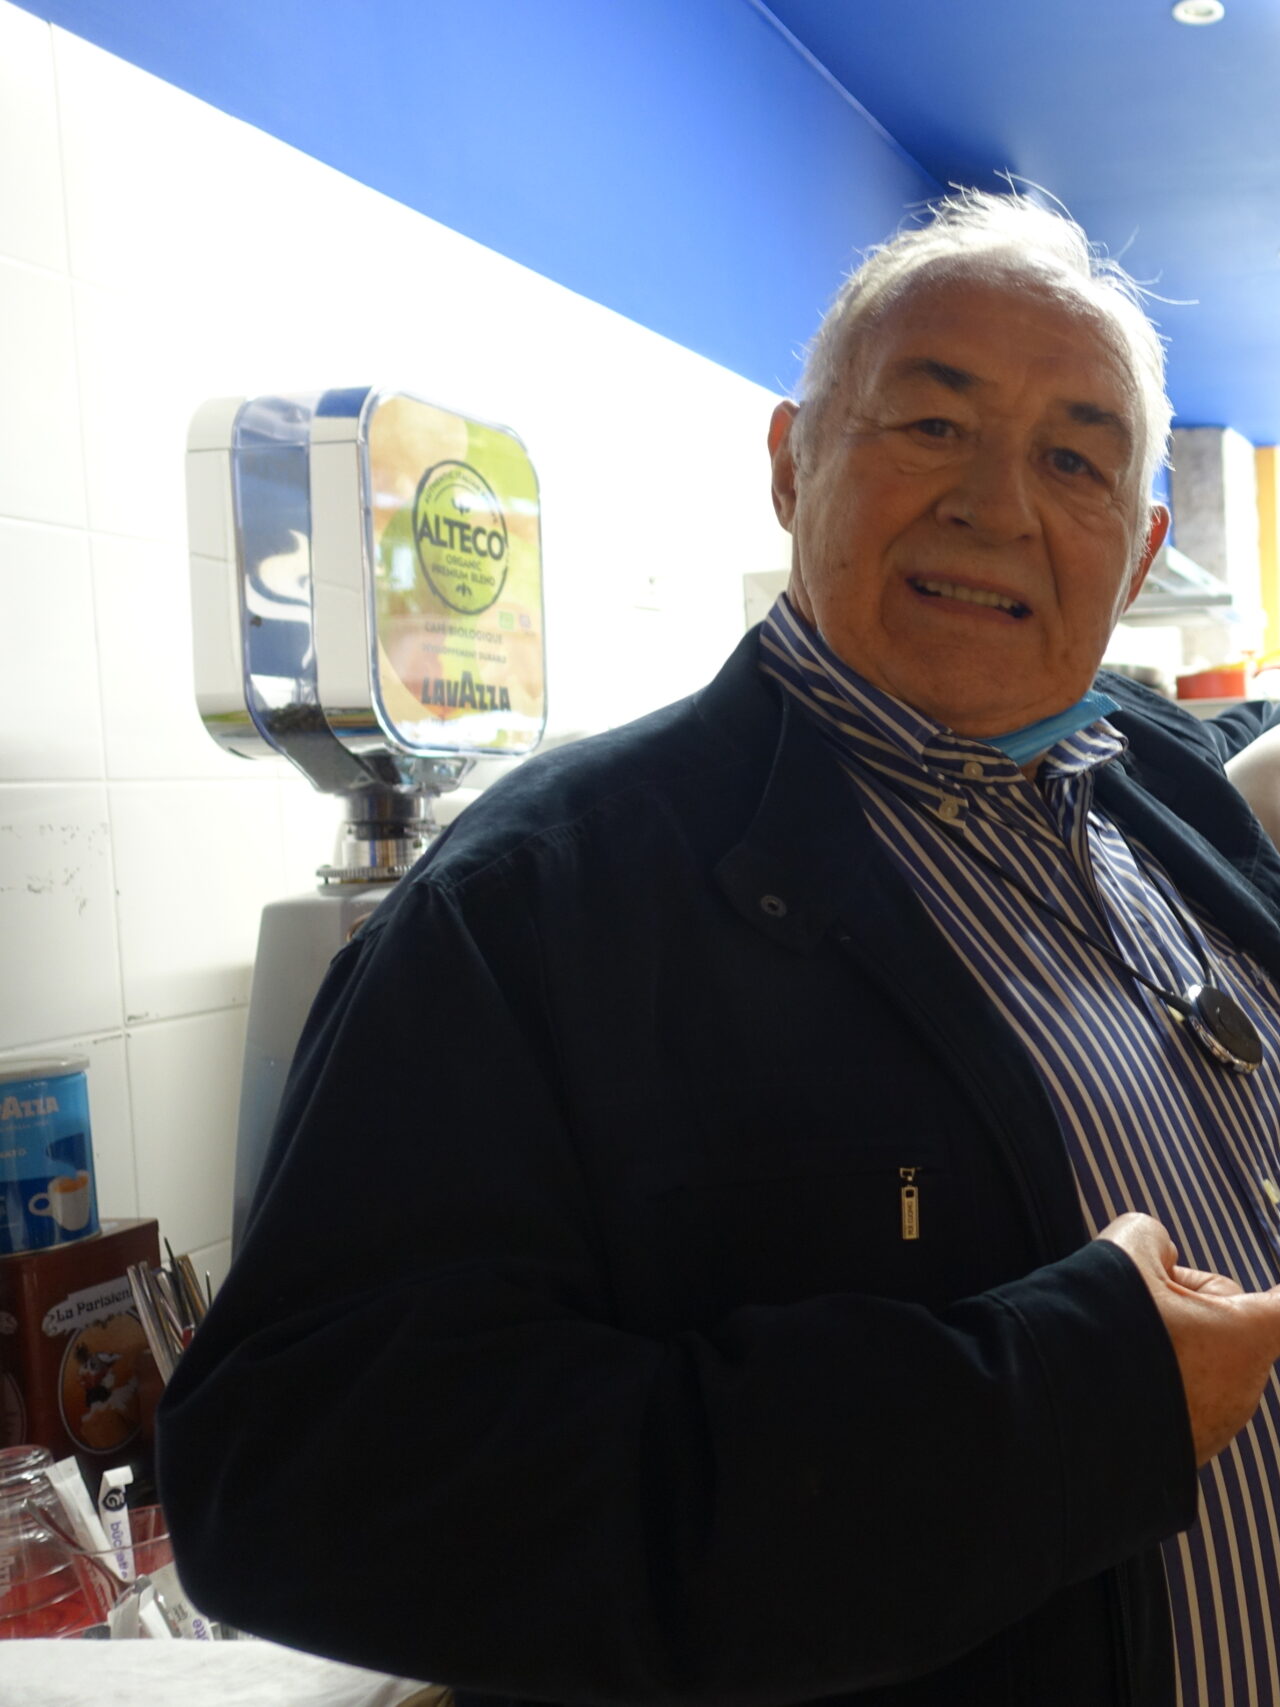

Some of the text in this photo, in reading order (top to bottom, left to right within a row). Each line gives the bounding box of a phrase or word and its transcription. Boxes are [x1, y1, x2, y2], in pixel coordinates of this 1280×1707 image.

[416, 511, 506, 561] ALTECO
[420, 670, 512, 713] LAVAZZA
[0, 1096, 60, 1121] AZZA
[55, 1307, 74, 1322] La
